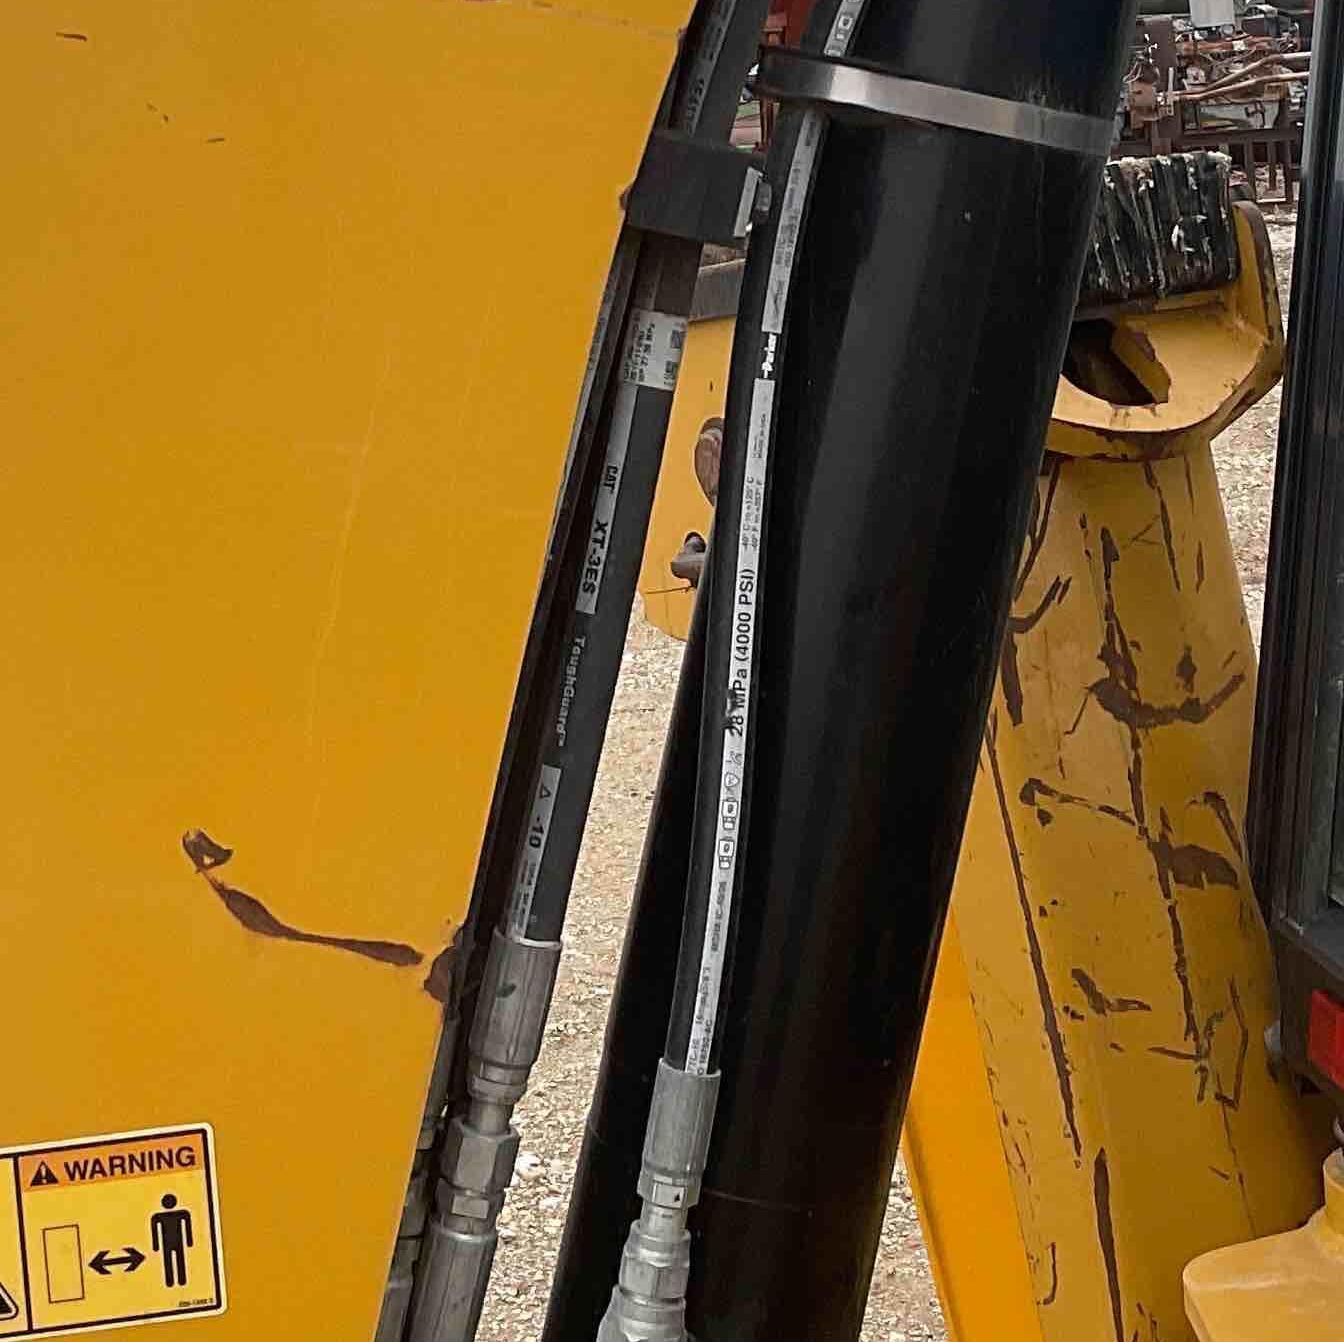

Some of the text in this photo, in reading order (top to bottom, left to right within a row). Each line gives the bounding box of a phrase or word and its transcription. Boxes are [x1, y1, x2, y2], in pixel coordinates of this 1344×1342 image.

[582, 465, 619, 595] CAT XT-3ES
[738, 568, 756, 607] PSI)
[735, 612, 752, 663] (4000
[732, 669, 748, 709] MPa
[728, 714, 744, 738] 28
[64, 1146, 196, 1181] WARNING
